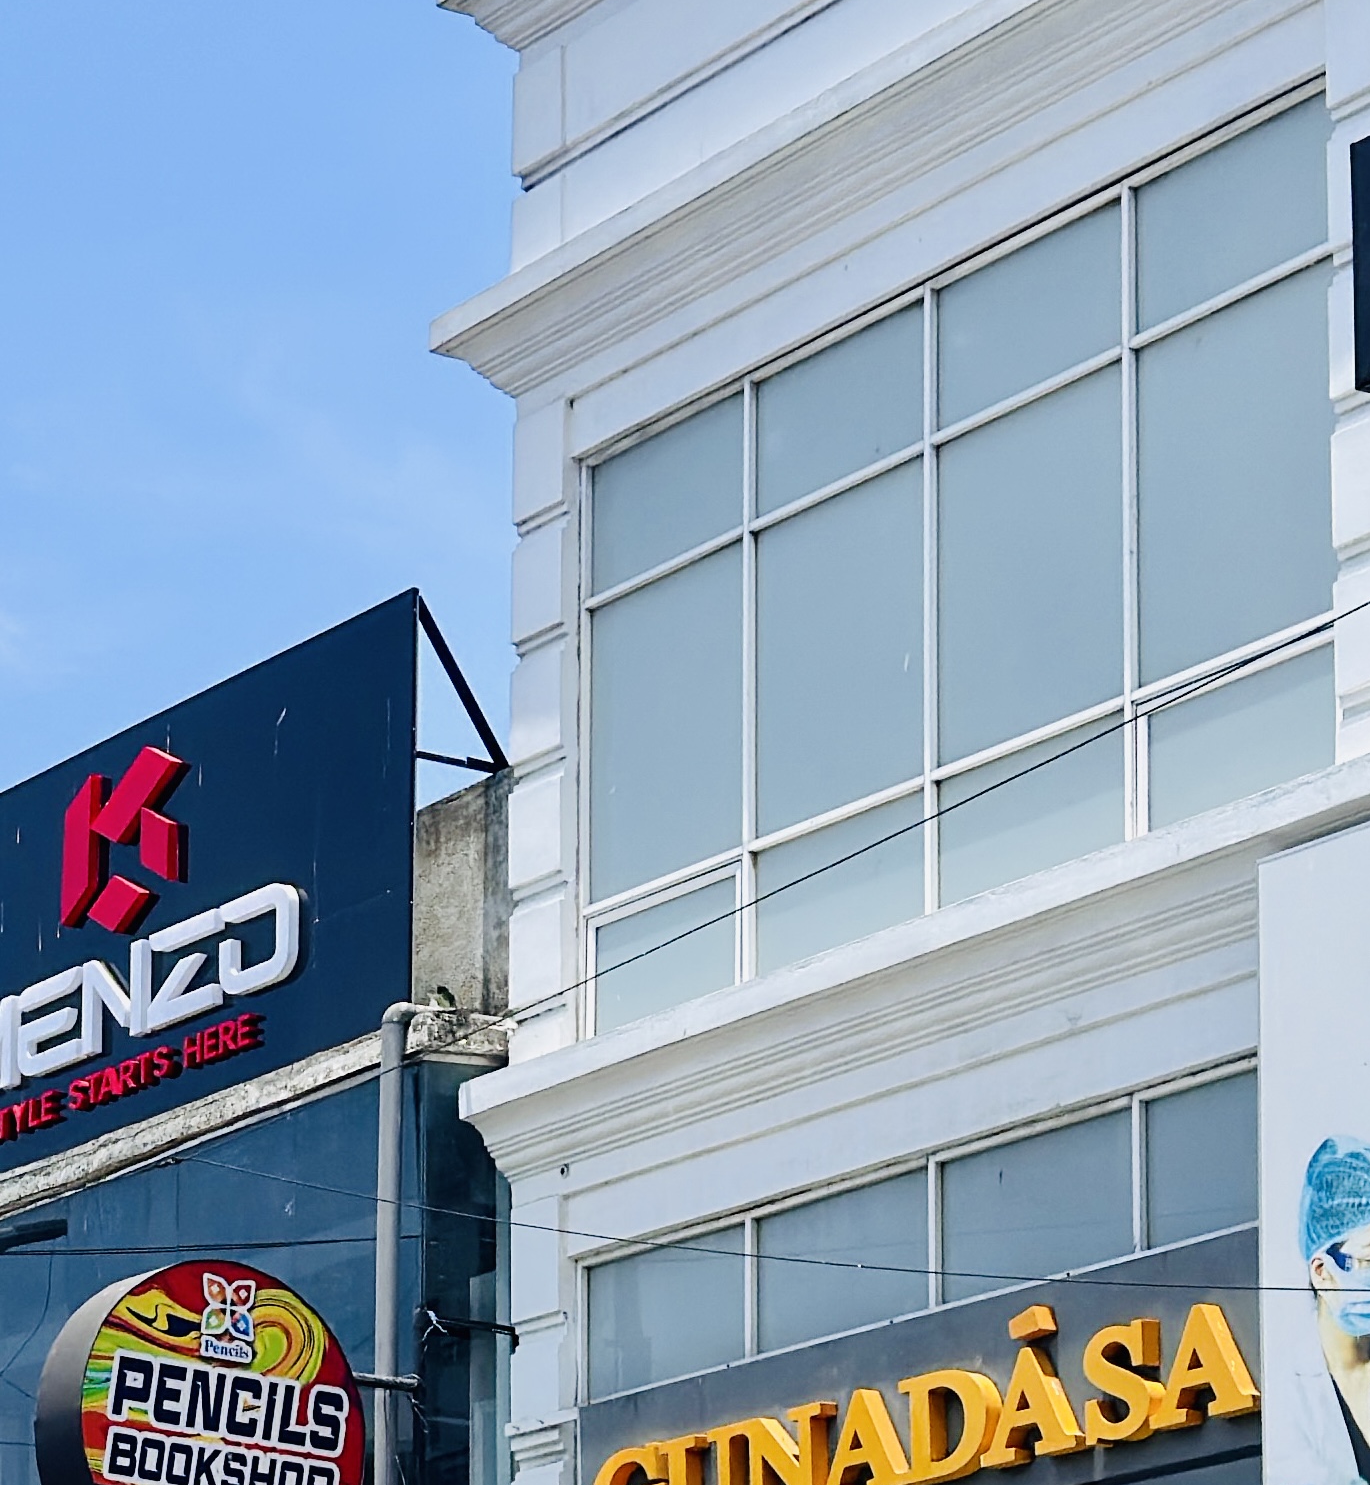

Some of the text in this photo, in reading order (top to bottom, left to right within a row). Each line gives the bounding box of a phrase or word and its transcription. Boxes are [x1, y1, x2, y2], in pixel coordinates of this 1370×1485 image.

[68, 1044, 178, 1110] STARTS
[183, 1012, 260, 1069] HERE
[110, 1353, 347, 1454] PENCILS
